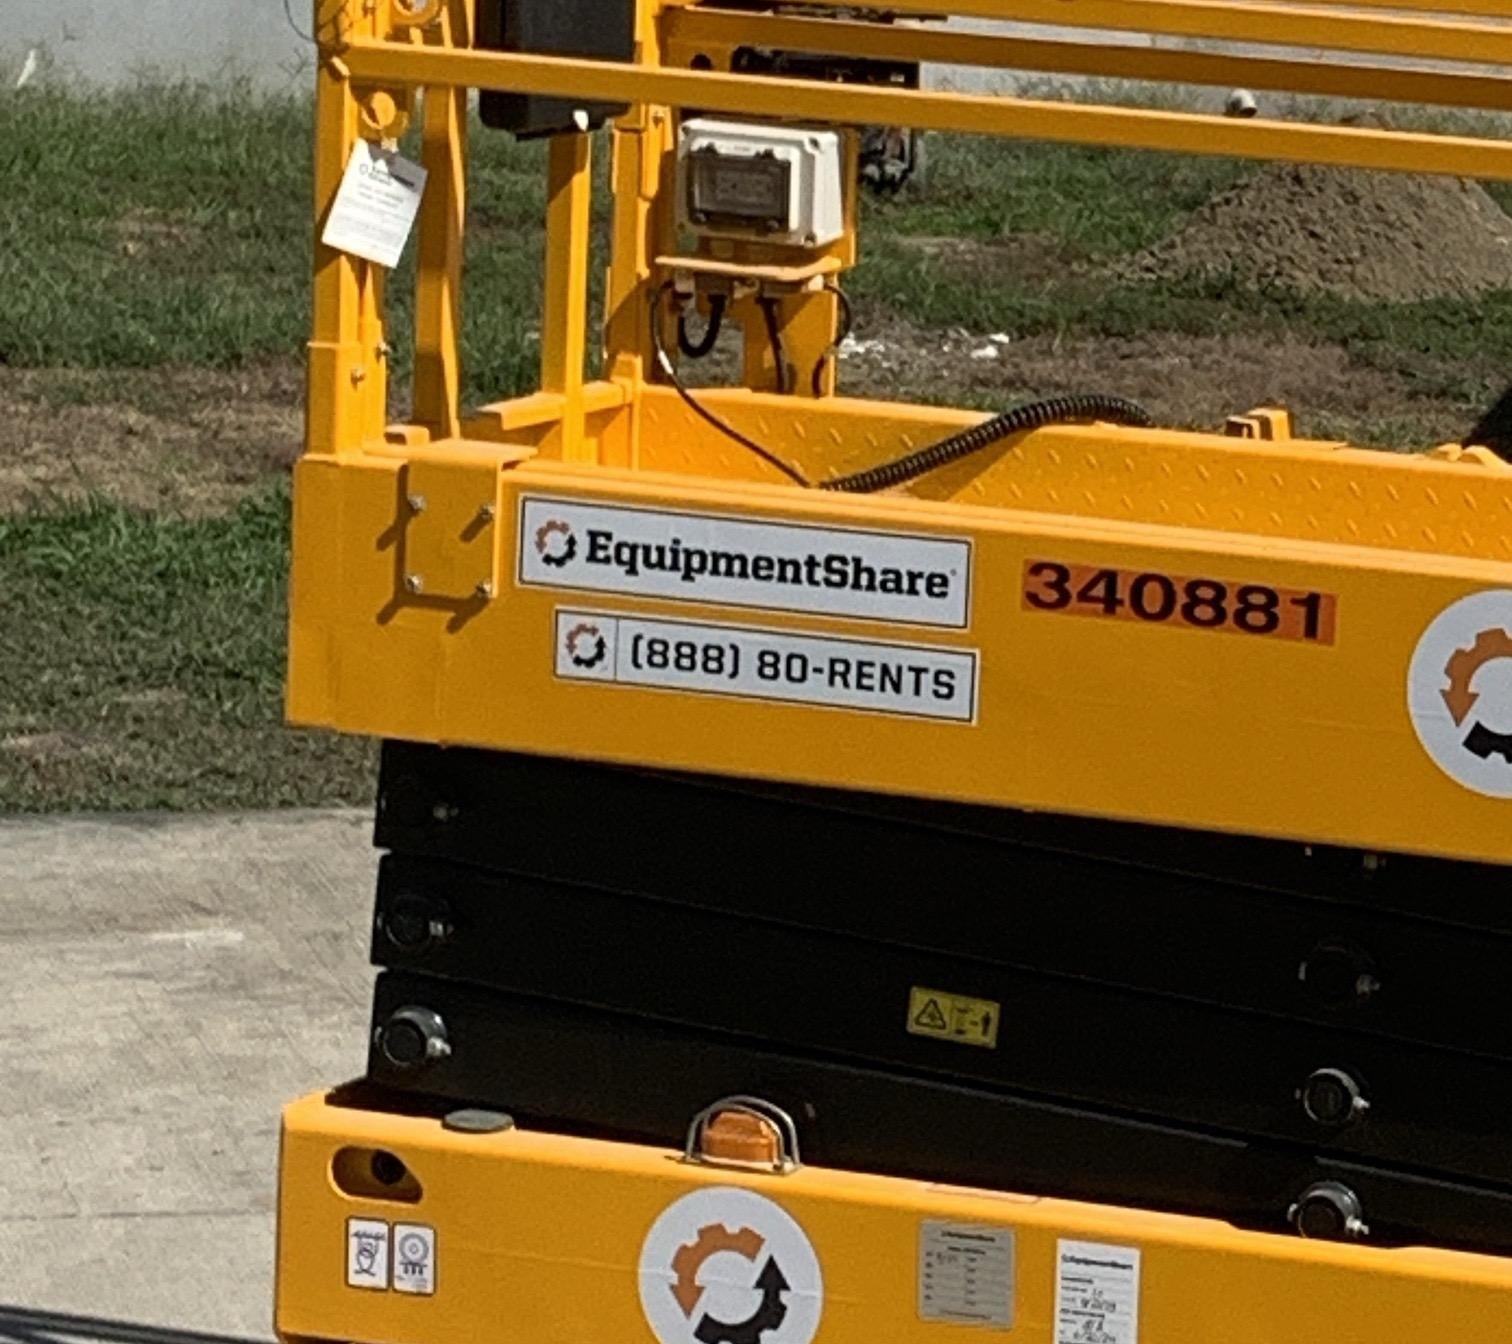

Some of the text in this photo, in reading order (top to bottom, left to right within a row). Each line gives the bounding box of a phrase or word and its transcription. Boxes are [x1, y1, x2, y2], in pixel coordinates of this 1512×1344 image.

[585, 529, 950, 599] EquipmentShare
[1025, 562, 1322, 641] 340881
[631, 633, 957, 701] (888) 80-RENTS
